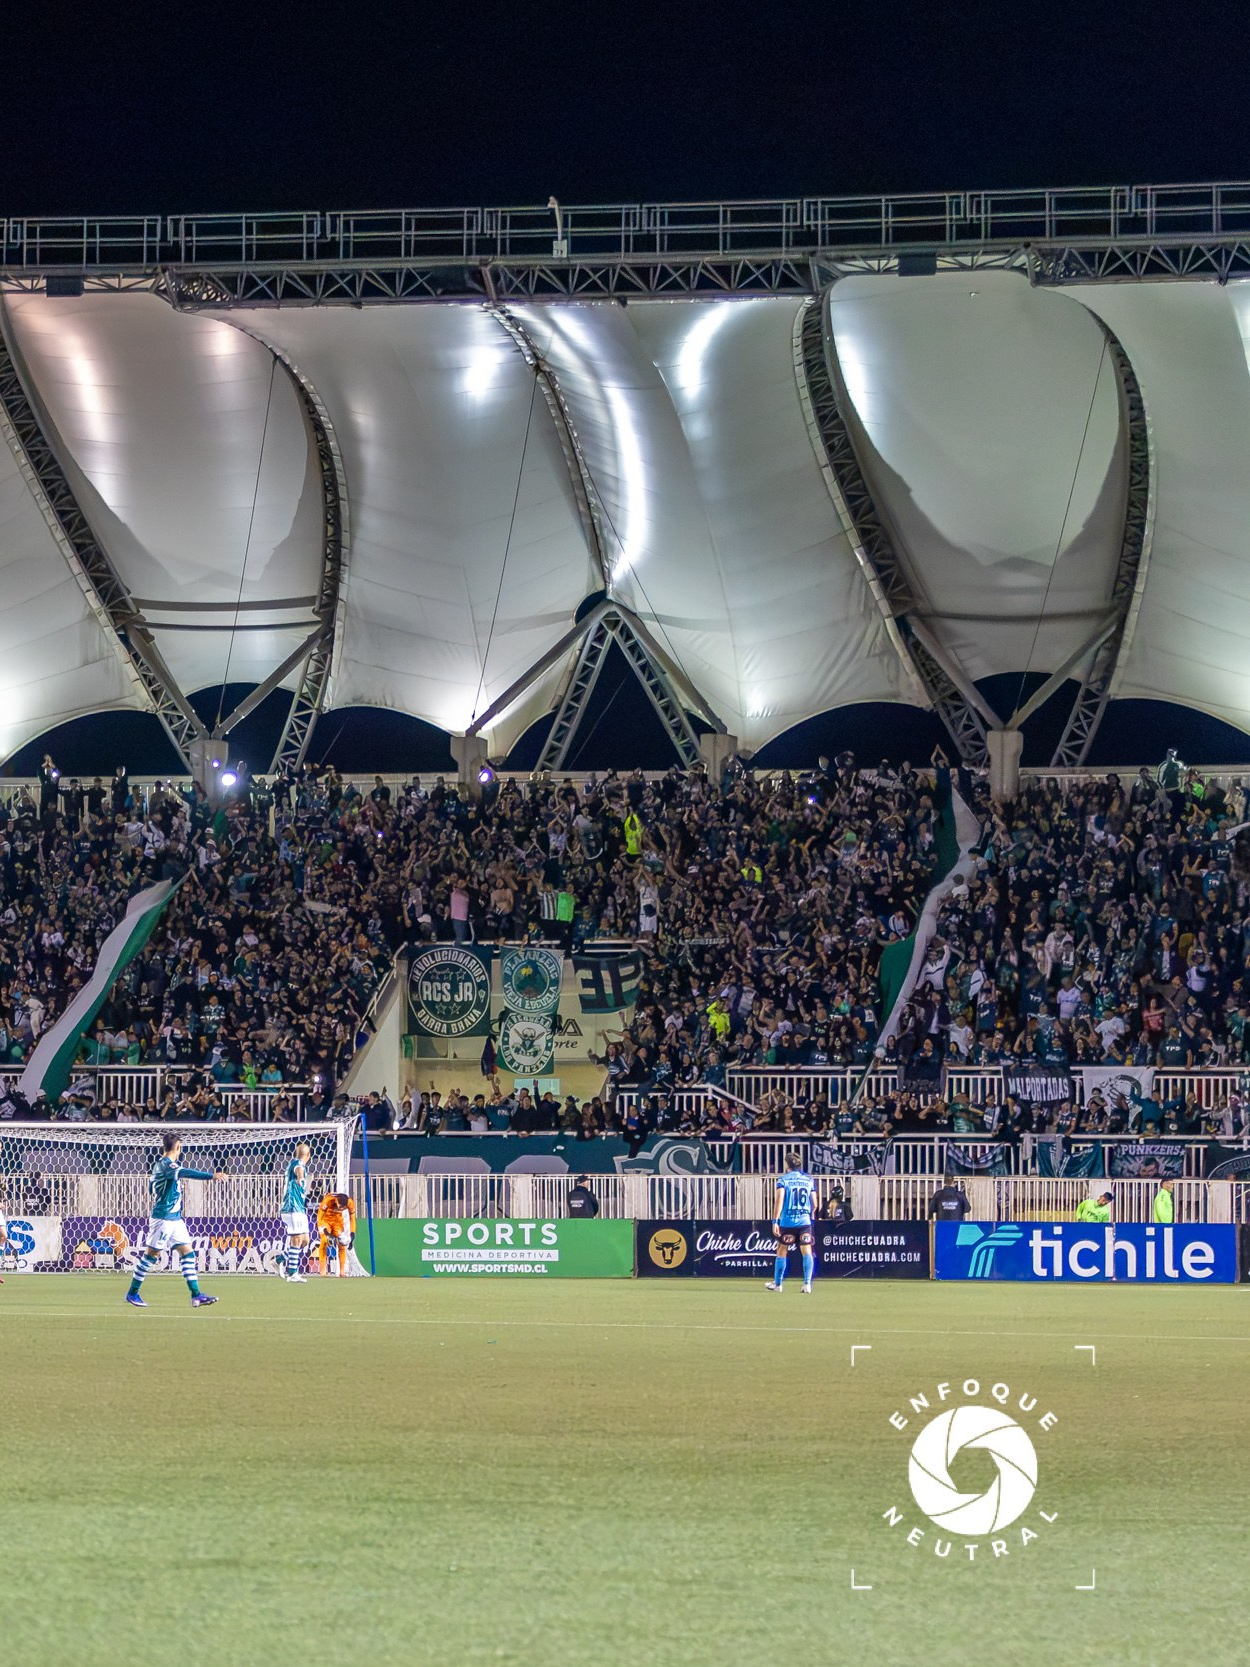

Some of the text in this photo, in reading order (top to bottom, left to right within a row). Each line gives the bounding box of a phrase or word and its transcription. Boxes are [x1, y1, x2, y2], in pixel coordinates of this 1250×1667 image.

[422, 981, 473, 1002] RCS JR
[451, 1009, 482, 1034] BRAVA
[1008, 1077, 1069, 1101] MALPORTADAS
[1121, 1144, 1181, 1156] PUNKZERS
[792, 1187, 807, 1207] 16
[159, 1231, 168, 1241] 14
[423, 1223, 558, 1245] SPORTS
[696, 1231, 797, 1252] Chiche Cuaa
[823, 1235, 906, 1246] @CHICHECUADRA
[824, 1252, 921, 1262] CHICHECUADRA.COM
[1029, 1226, 1215, 1279] tichile
[433, 1263, 548, 1273] WWW.SPORTSMD.CL
